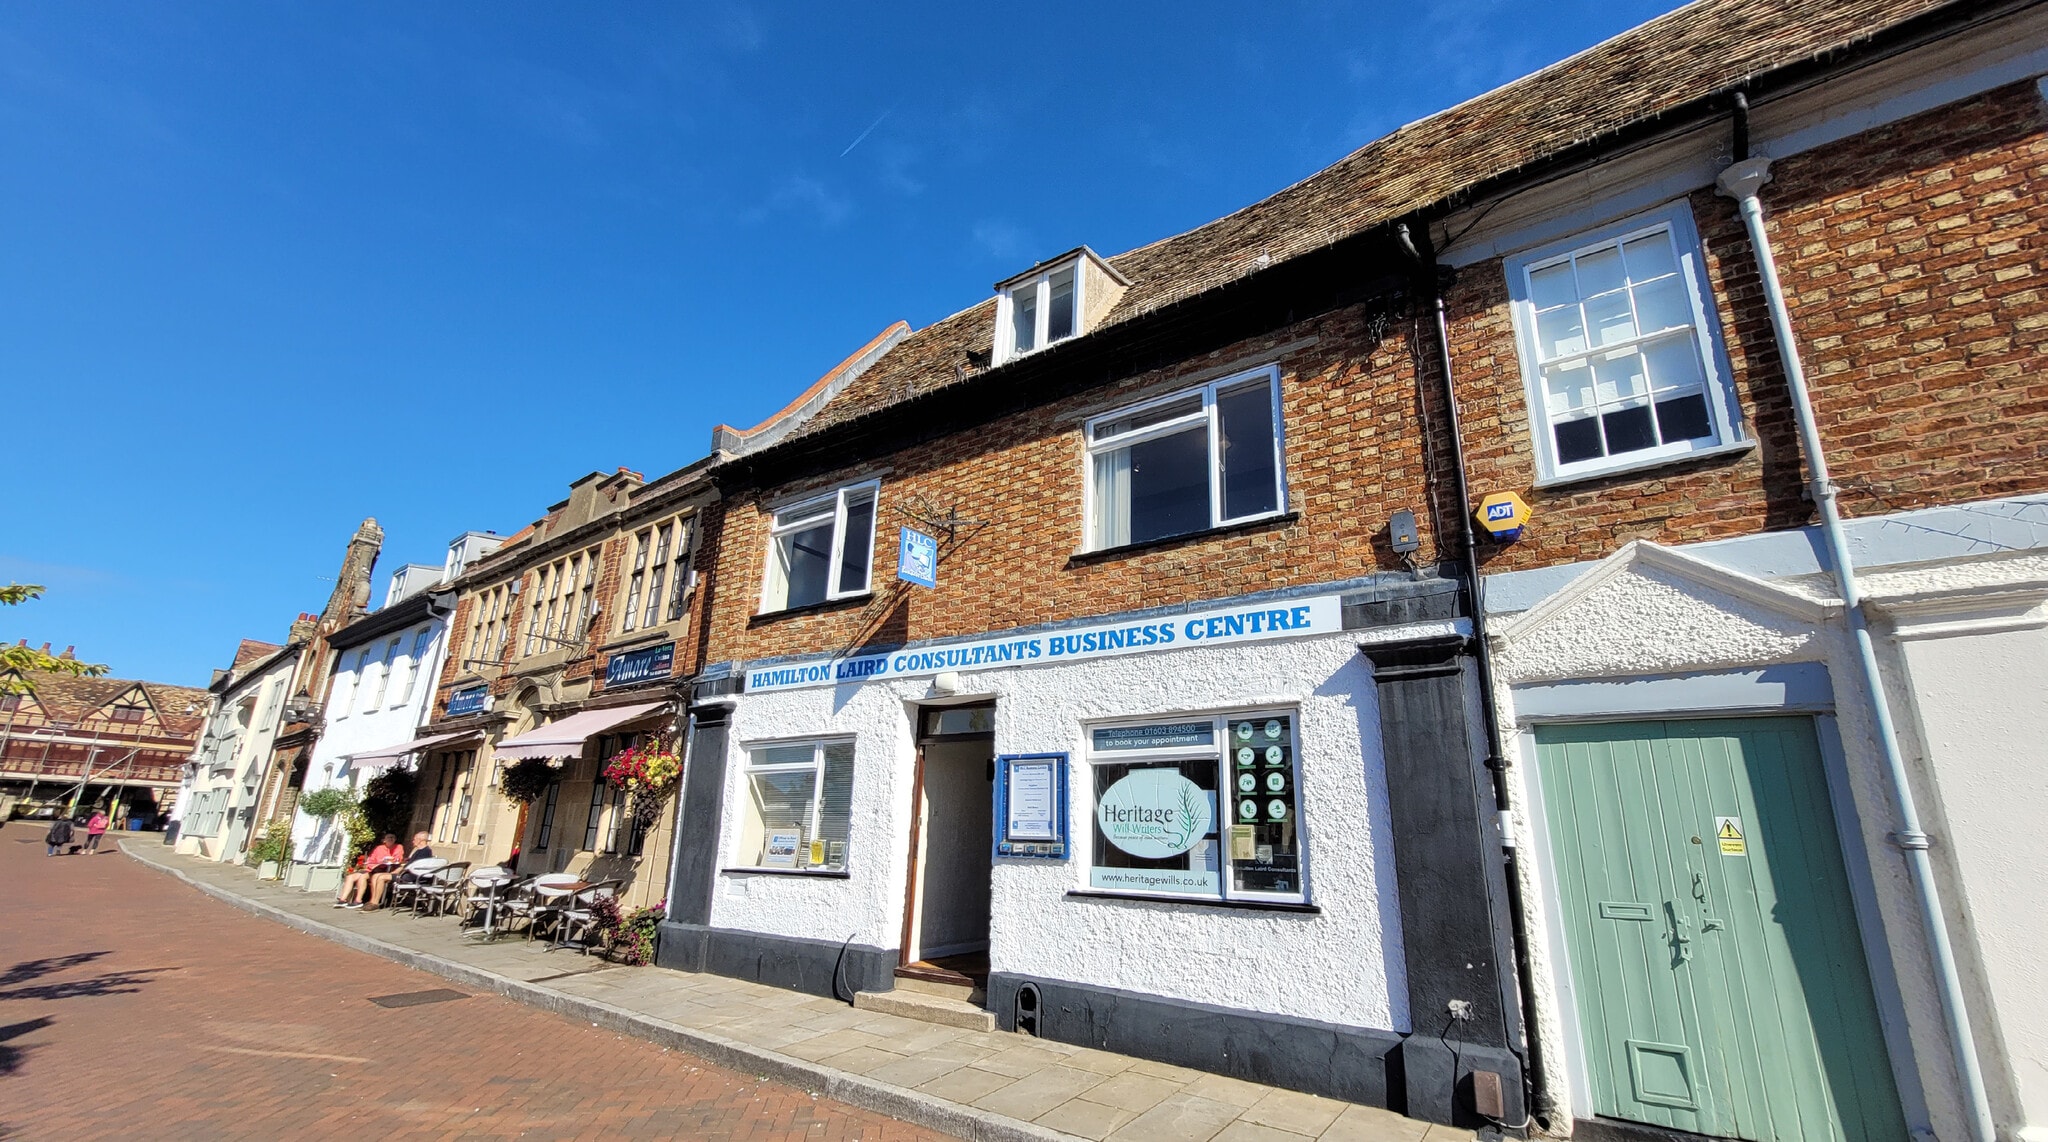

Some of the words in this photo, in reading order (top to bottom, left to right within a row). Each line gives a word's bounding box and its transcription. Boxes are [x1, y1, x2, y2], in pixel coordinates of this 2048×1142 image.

[1488, 504, 1513, 520] ADT
[905, 530, 933, 548] HLC
[751, 664, 831, 689] HAMILTON
[835, 658, 889, 680] LAIRD
[894, 639, 1041, 673] CONSULTANTS
[1048, 622, 1176, 657] BUSINESS
[1184, 605, 1312, 641] CENTRE
[606, 655, 652, 684] Amore
[1108, 730, 1143, 738] Telephone
[1144, 727, 1167, 736] 01603
[1168, 724, 1196, 734] 894500
[1114, 738, 1132, 746] book
[1133, 739, 1149, 747] your
[1151, 735, 1198, 746] appointment
[1104, 804, 1174, 825] Heritage
[1113, 823, 1129, 834] Will
[1132, 823, 1162, 834] Writers
[1101, 873, 1209, 887] www.heritagewills.co.uk
